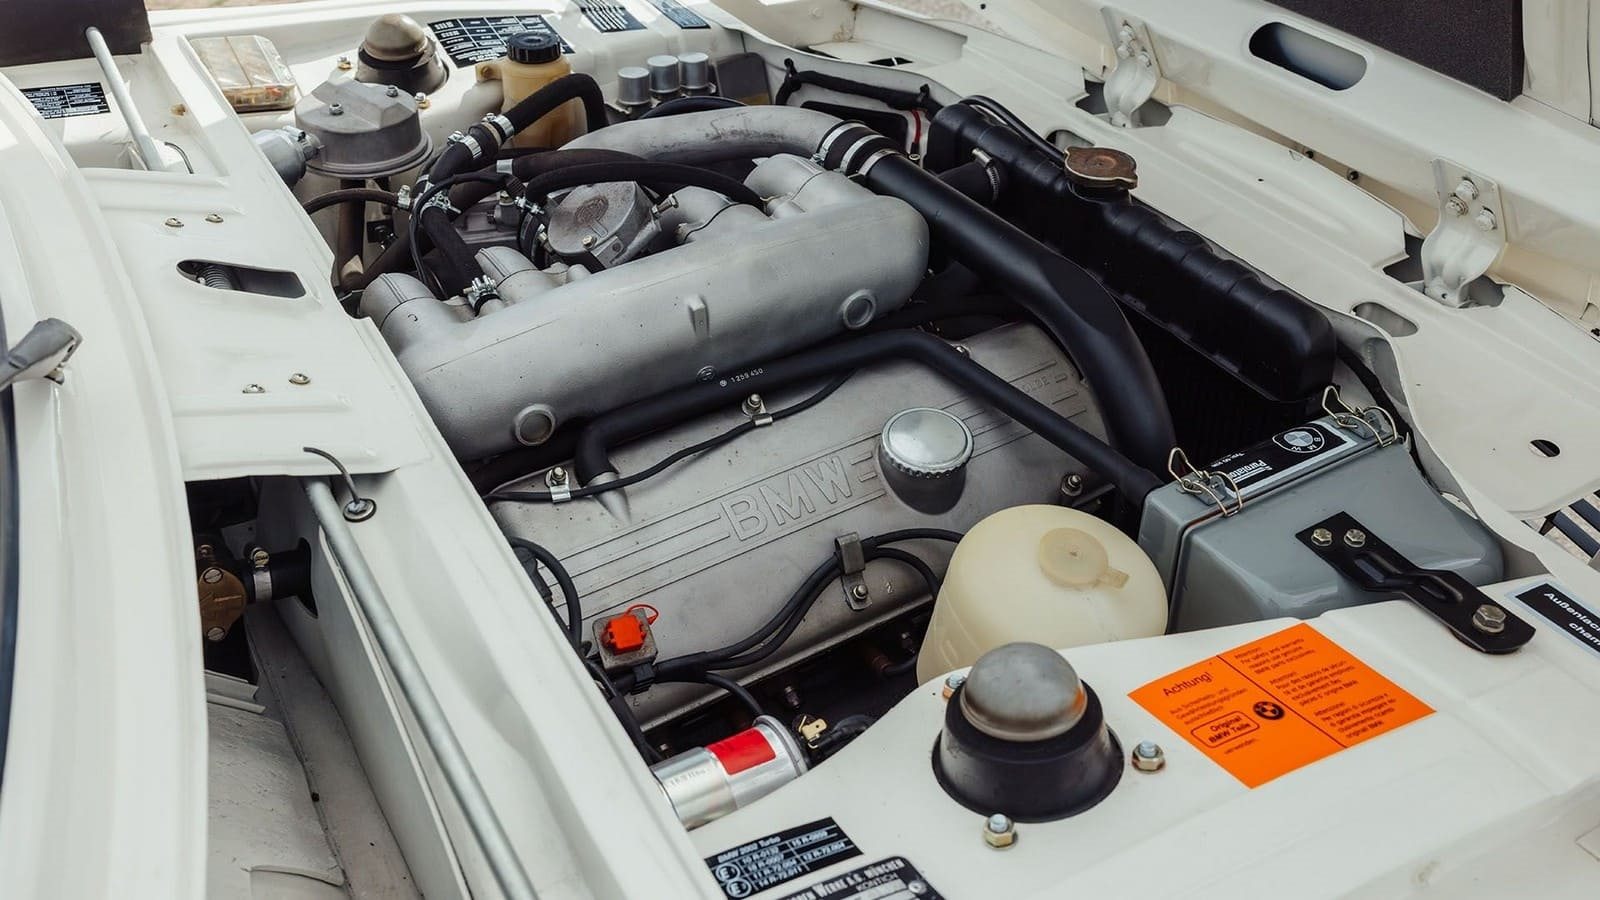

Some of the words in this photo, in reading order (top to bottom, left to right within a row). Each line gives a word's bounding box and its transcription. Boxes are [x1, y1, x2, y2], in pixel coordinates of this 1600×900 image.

[721, 455, 852, 542] BMW
[1544, 592, 1600, 632] Außenlac
[1163, 671, 1212, 696] Achtung!
[1208, 730, 1230, 742] BMW
[1231, 723, 1250, 732] Teile
[1210, 716, 1241, 731] Original
[718, 849, 738, 863] BMW
[758, 836, 780, 848] Turbo
